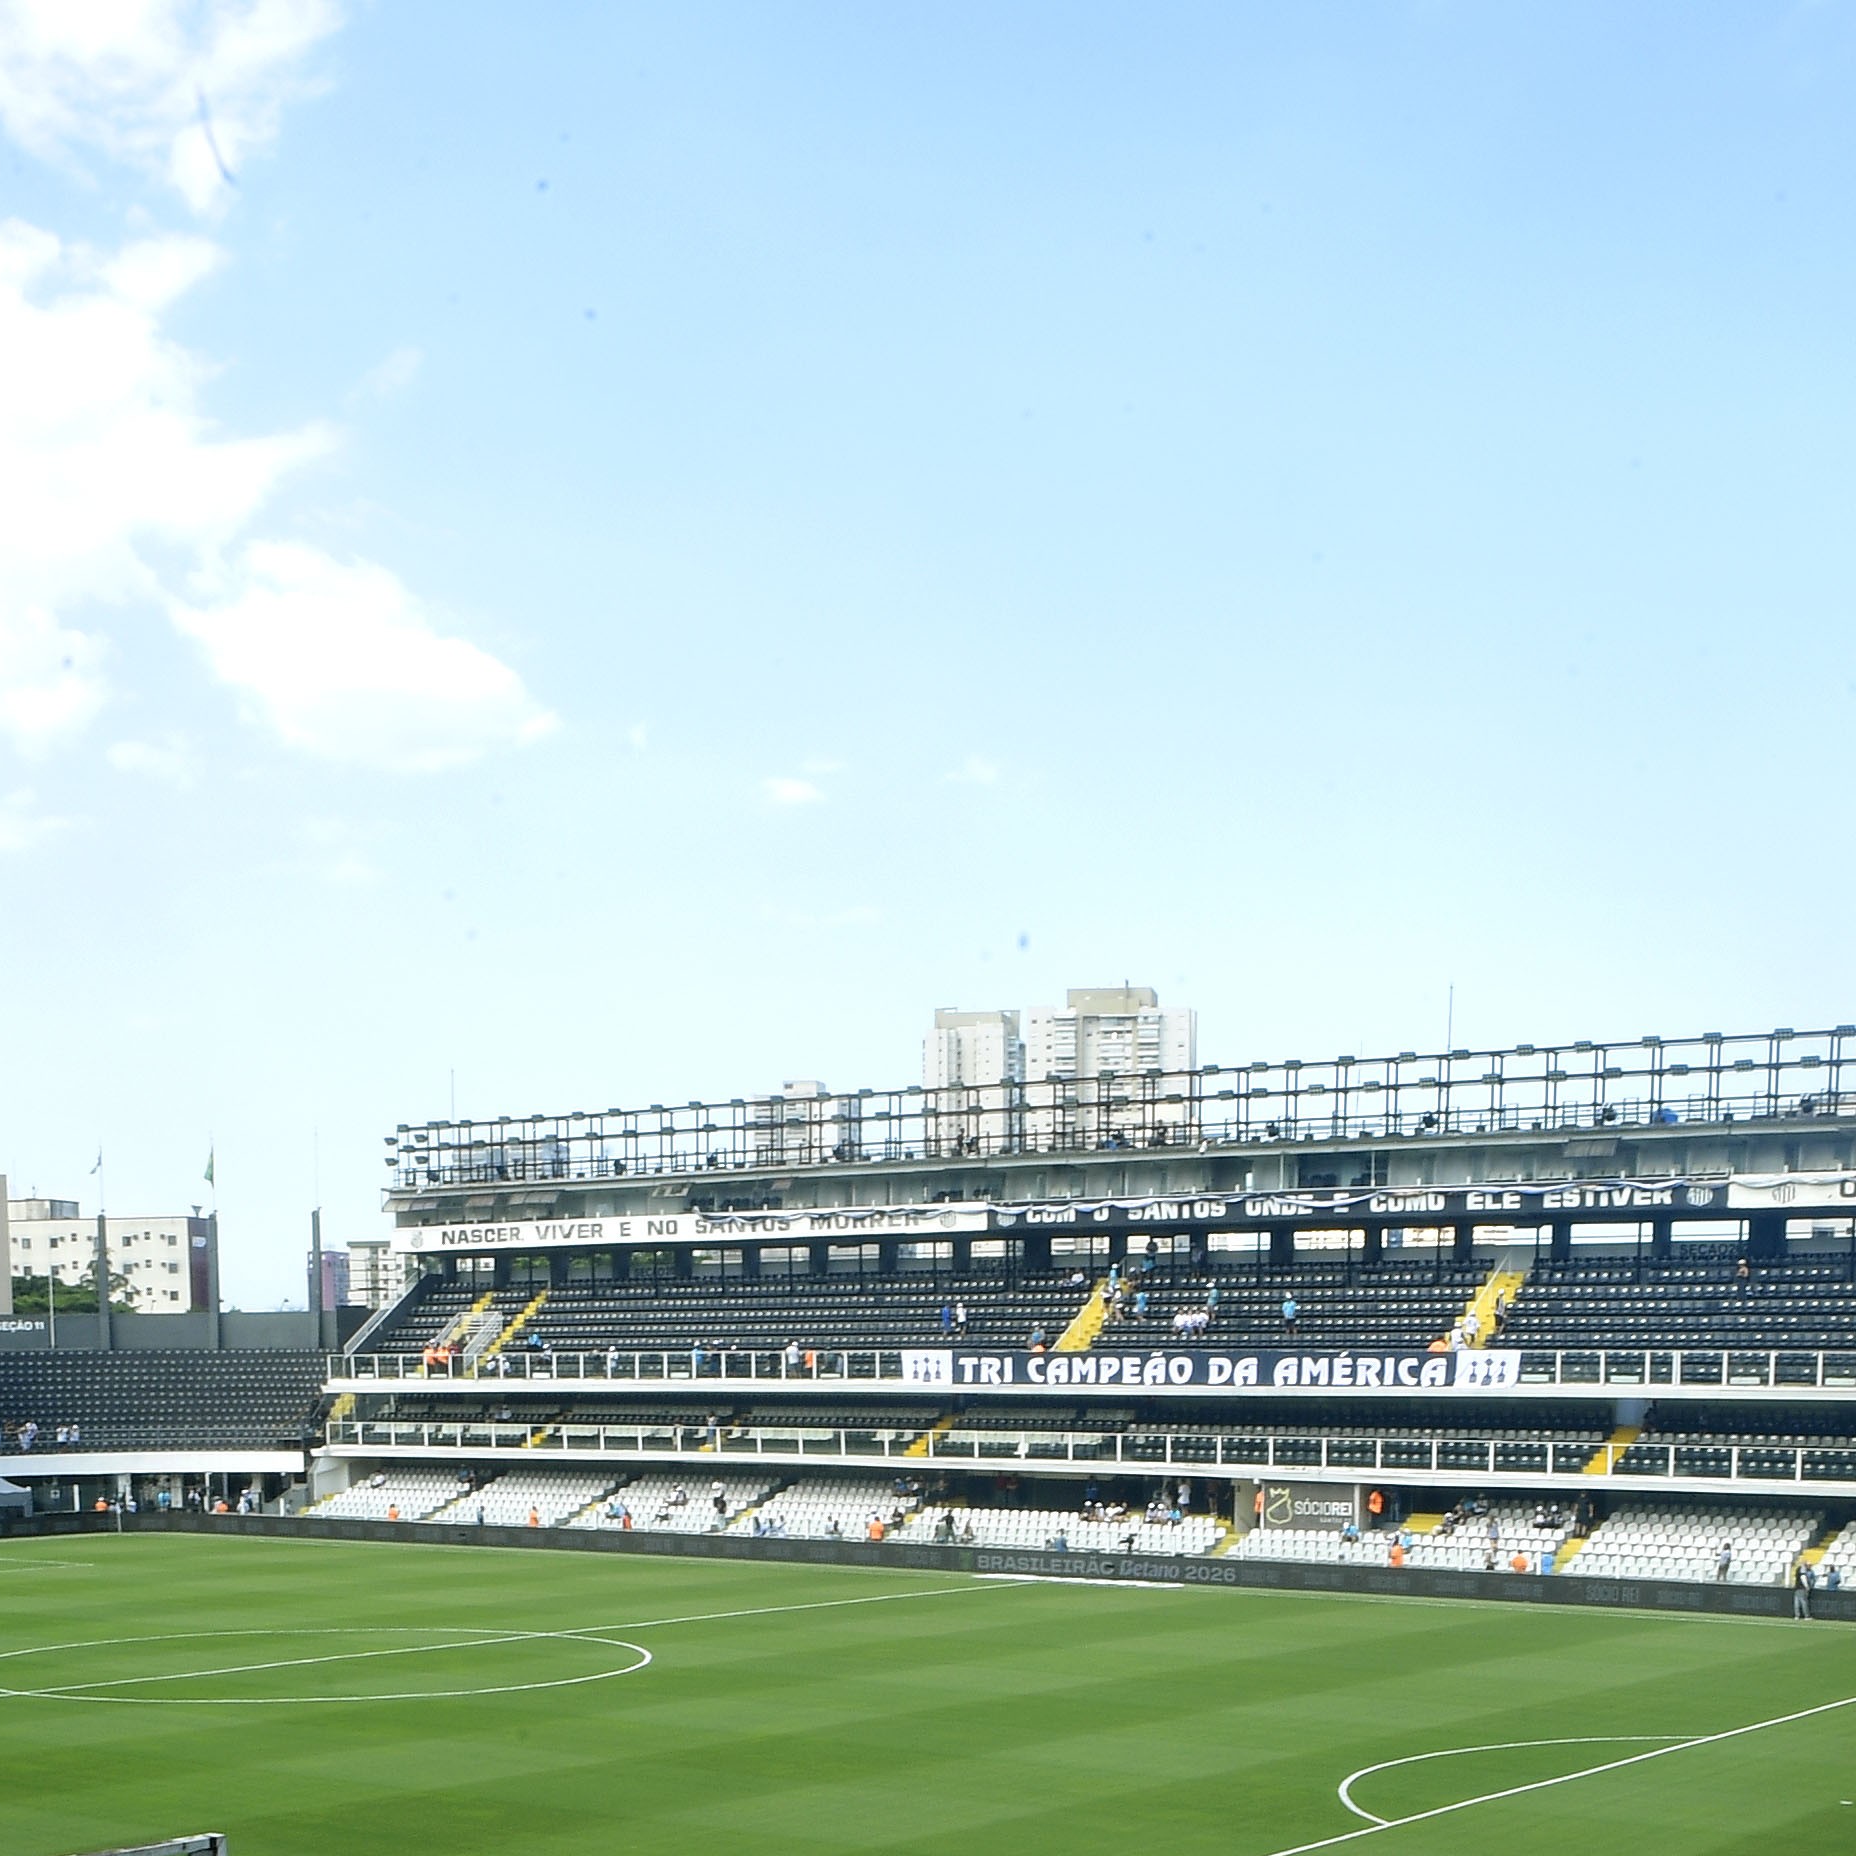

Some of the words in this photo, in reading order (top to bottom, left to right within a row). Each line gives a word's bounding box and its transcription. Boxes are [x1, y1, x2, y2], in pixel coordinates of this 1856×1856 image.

[1128, 1199, 1227, 1222] SANTOS
[1246, 1193, 1313, 1217] ONDE
[1466, 1190, 1521, 1212] ELE
[1543, 1187, 1673, 1209] ESTIVER
[536, 1223, 604, 1240] VIVER
[620, 1221, 632, 1237] E
[647, 1219, 678, 1236] NO
[958, 1356, 1013, 1384] TRI
[1026, 1351, 1193, 1385] CAMPEÃO
[1207, 1357, 1259, 1386] DA
[1273, 1351, 1448, 1387] AMÉRICA
[1120, 1559, 1180, 1579] Betano
[1184, 1566, 1237, 1583] 2026
